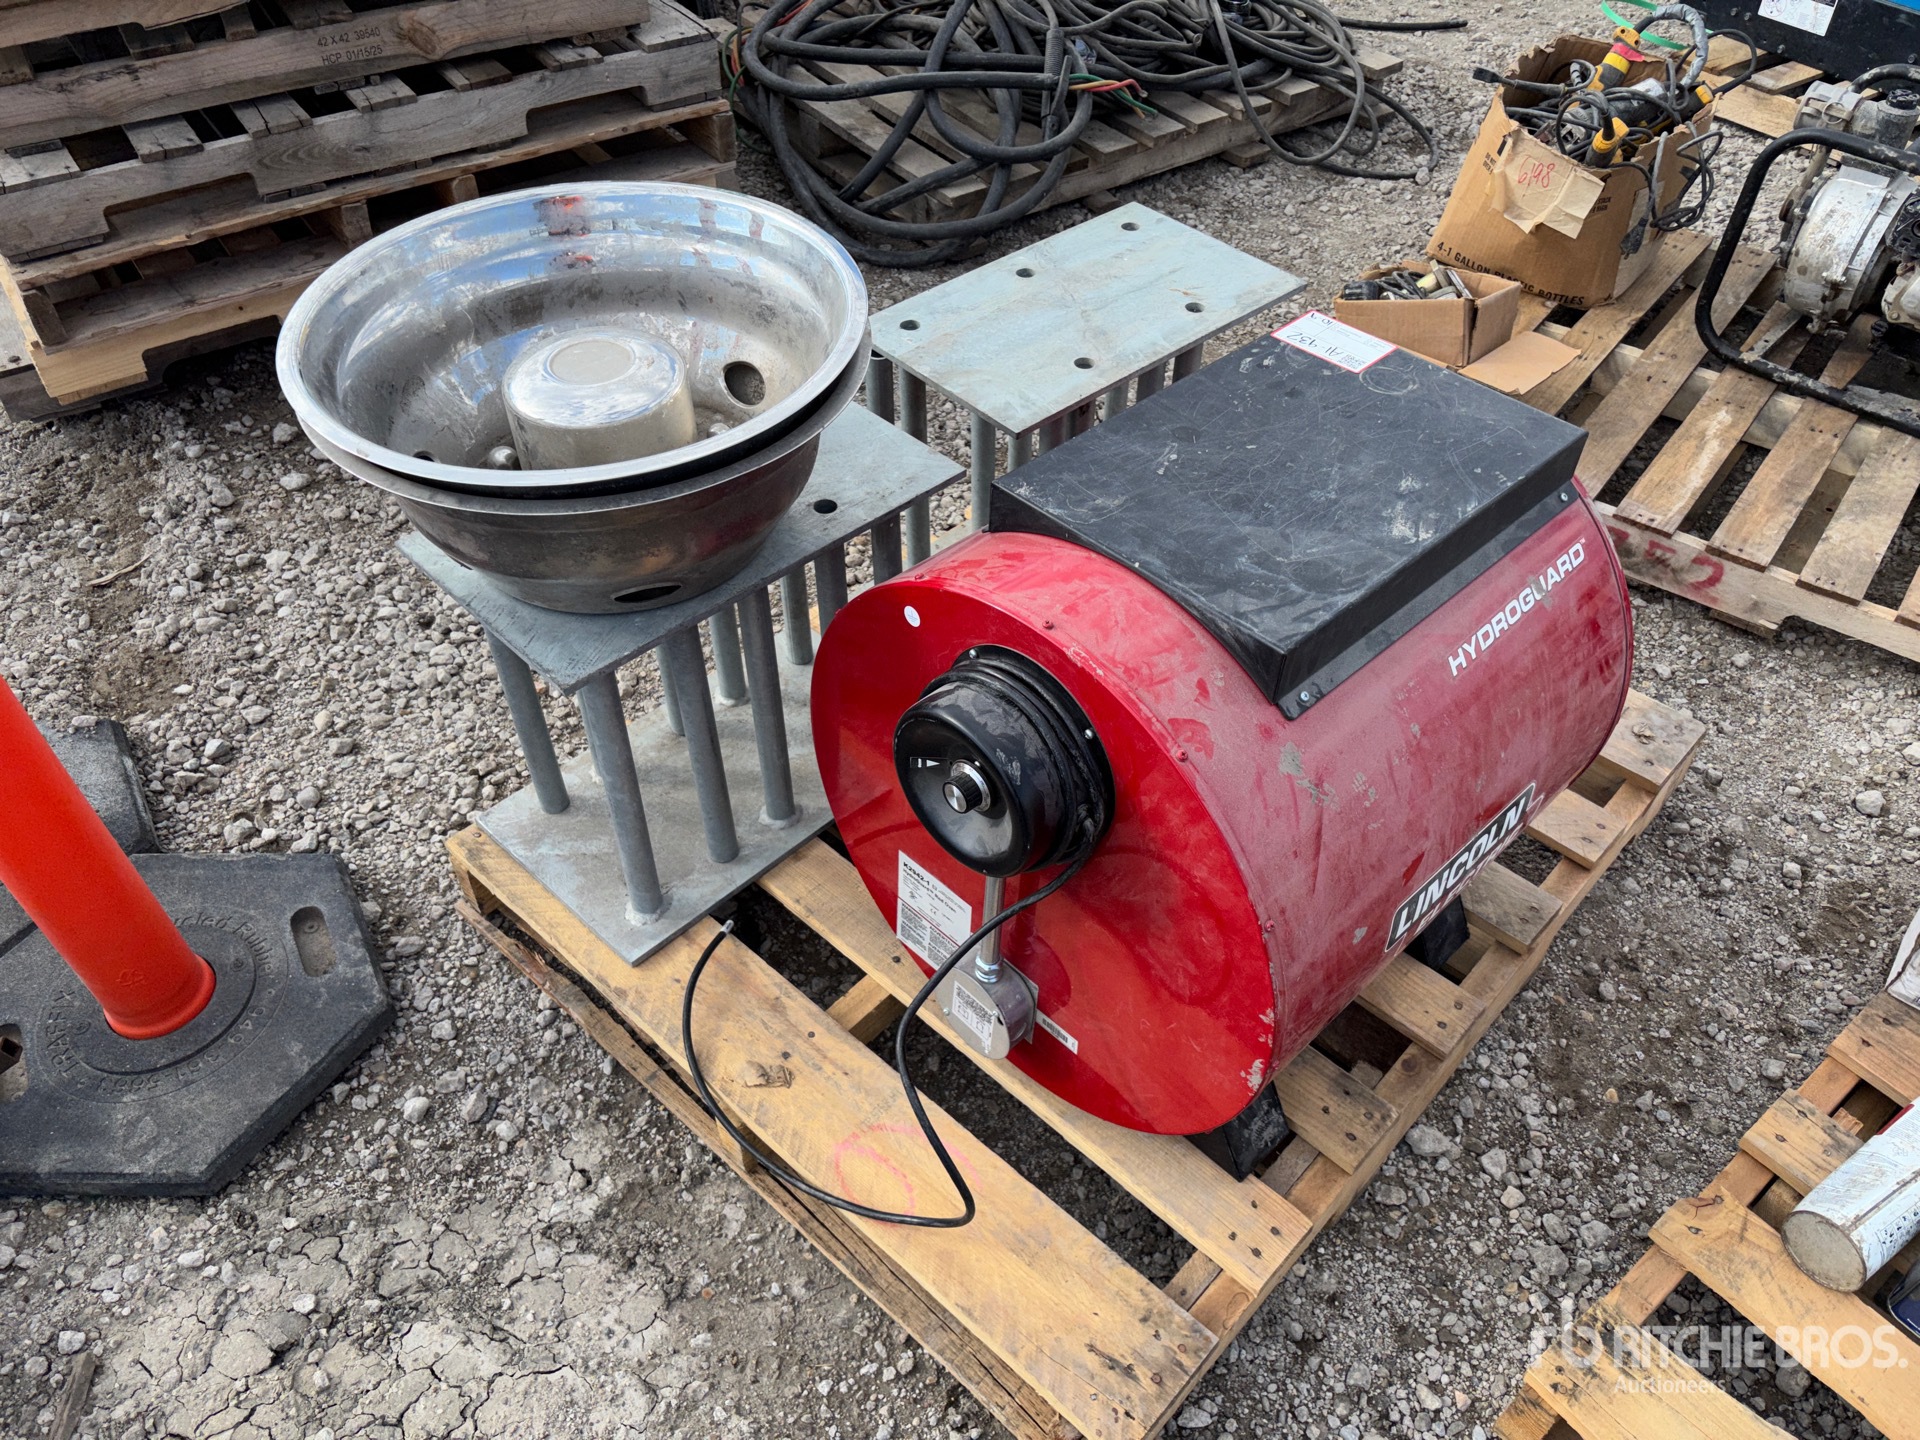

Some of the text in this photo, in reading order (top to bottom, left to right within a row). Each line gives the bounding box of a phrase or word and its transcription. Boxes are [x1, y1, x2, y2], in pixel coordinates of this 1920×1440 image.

[317, 36, 329, 47] 42
[339, 32, 350, 43] 42
[354, 27, 381, 40] 39540
[321, 45, 383, 65] HCP 01/15/25
[1437, 241, 1452, 257] 4-1
[1454, 252, 1491, 275] GALLON
[1537, 289, 1585, 306] BOTTLES
[1395, 797, 1527, 940] LINCOLN
